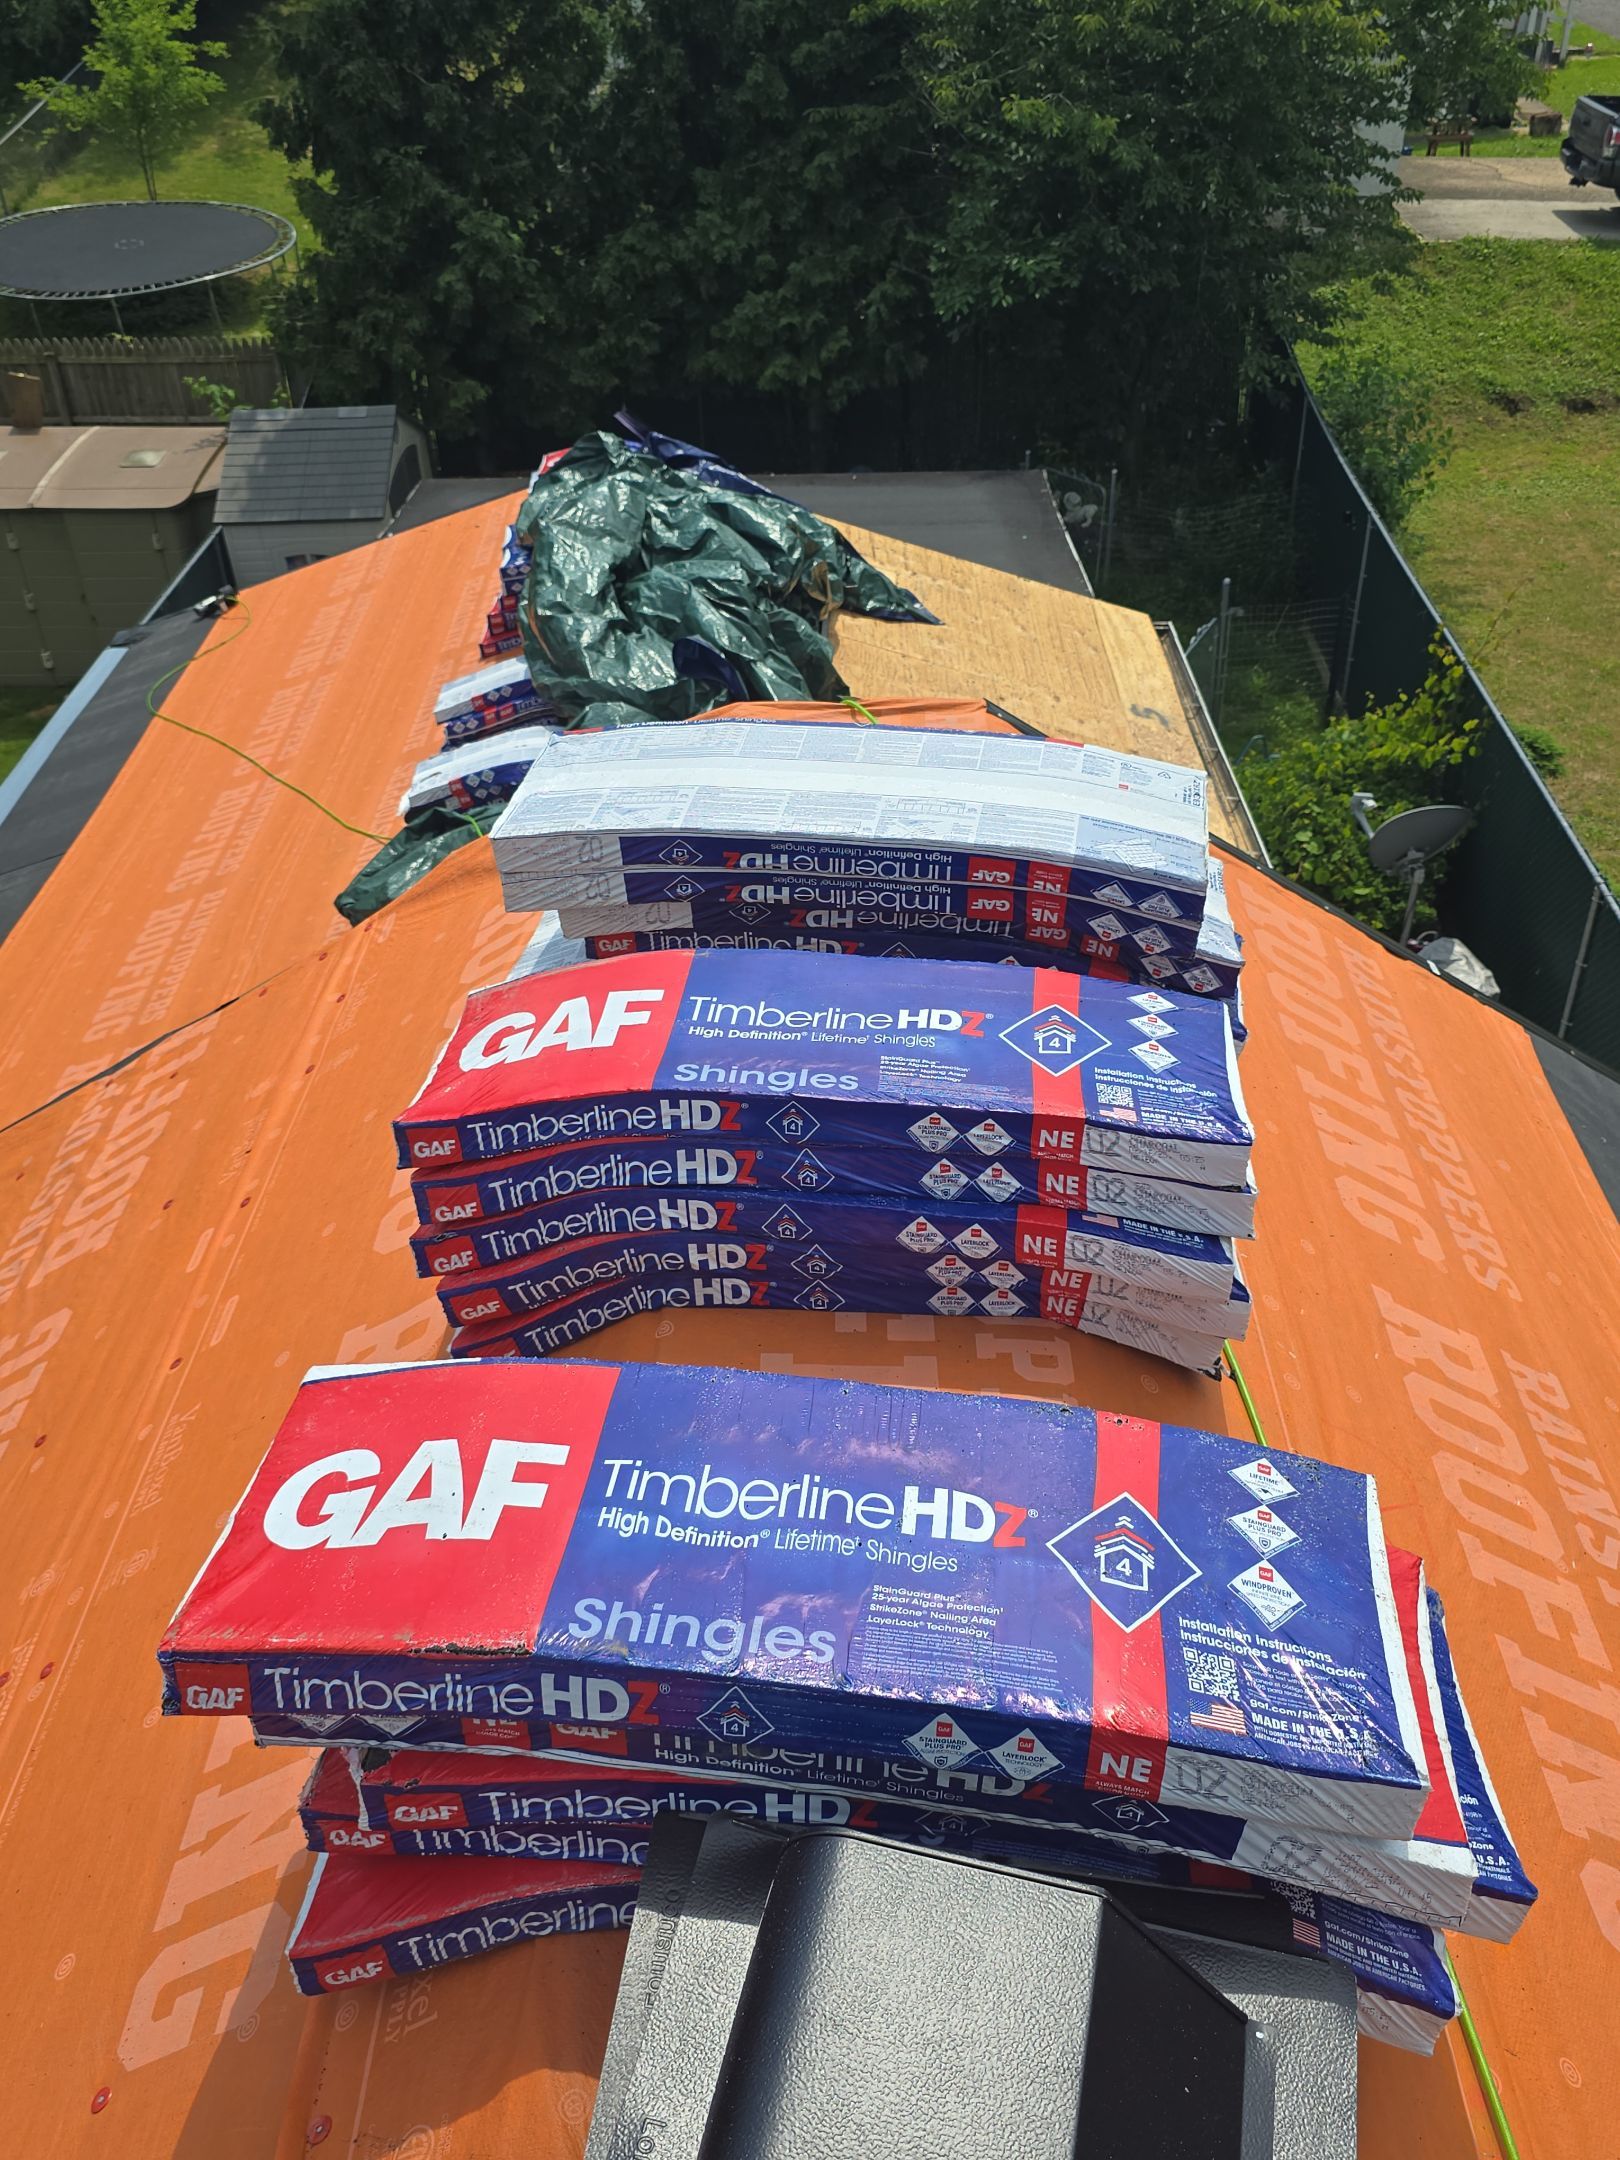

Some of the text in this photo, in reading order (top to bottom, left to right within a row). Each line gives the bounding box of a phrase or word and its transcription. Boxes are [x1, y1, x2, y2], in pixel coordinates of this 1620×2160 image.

[771, 843, 817, 855] Shingles
[925, 851, 952, 863] High
[772, 875, 818, 887] Shingles
[971, 870, 1011, 885] GAF
[924, 882, 951, 895] High
[1033, 880, 1061, 895] NE
[971, 898, 1010, 911] GAF
[1032, 907, 1059, 925] NE
[1030, 927, 1067, 941] GAF
[599, 938, 632, 951] GAF
[1086, 938, 1114, 958] NE
[458, 989, 665, 1073] GAF
[688, 1025, 725, 1039] High
[874, 1033, 936, 1048] Shingles
[1049, 1037, 1061, 1048] 4
[674, 1063, 859, 1092] Shingles
[1094, 1066, 1144, 1080] Installation
[1237, 878, 1446, 1262] ROOFING
[1094, 1074, 1155, 1089] Instrucciones
[1156, 1084, 1168, 1092] de
[1141, 1111, 1167, 1121] MADE
[1334, 936, 1522, 1302] RAINSTOPPERS
[414, 1139, 456, 1158] GAF
[1039, 1129, 1075, 1149] NE
[1046, 1173, 1079, 1195] NE
[435, 1202, 477, 1223] GAF
[1123, 1218, 1148, 1230] MADE
[1160, 1228, 1176, 1237] THE
[1023, 1234, 1057, 1258] NE
[434, 1250, 474, 1273] GAF
[1050, 1270, 1083, 1289] NE
[460, 1300, 501, 1320] GAF
[1047, 1296, 1078, 1316] NE
[1249, 1473, 1280, 1486] LIFETIME
[263, 1439, 570, 1550] GAF
[1242, 1517, 1287, 1533] STAINGUARD
[1248, 1524, 1282, 1538] PLUS PRO
[598, 1506, 649, 1538] High
[866, 1539, 958, 1572] Shingles
[1116, 1558, 1132, 1577] 4
[873, 1585, 932, 1600] StainGuard
[1241, 1578, 1294, 1599] WINDPROVEN
[872, 1593, 909, 1604] 25-year
[912, 1598, 944, 1609] Algae
[930, 1611, 969, 1624] Nailing
[971, 1616, 997, 1627] Area
[568, 1598, 836, 1664] Shingles
[927, 1622, 990, 1639] Technology
[1179, 1616, 1251, 1643] Installation
[1181, 1629, 1268, 1659] Instrucciones
[1271, 1652, 1289, 1665] de
[186, 1686, 245, 1710] GAF
[1252, 1712, 1288, 1731] MADE
[1292, 1722, 1305, 1734] IN
[1308, 1725, 1330, 1739] THE
[919, 1736, 967, 1746] STAINGUARD
[1005, 1758, 1043, 1768] TECHNOLOGY
[1100, 1752, 1152, 1783] NE
[655, 1748, 700, 1764] High
[887, 1780, 965, 1802] Shingles
[1096, 1781, 1121, 1790] ALWAYS
[1124, 1785, 1150, 1795] MATCH
[394, 1805, 458, 1823] GAF
[1326, 1932, 1355, 1951] MADE
[1356, 1946, 1368, 1957] IN
[1370, 1951, 1390, 1965] THE
[325, 1960, 384, 1985] GAF
